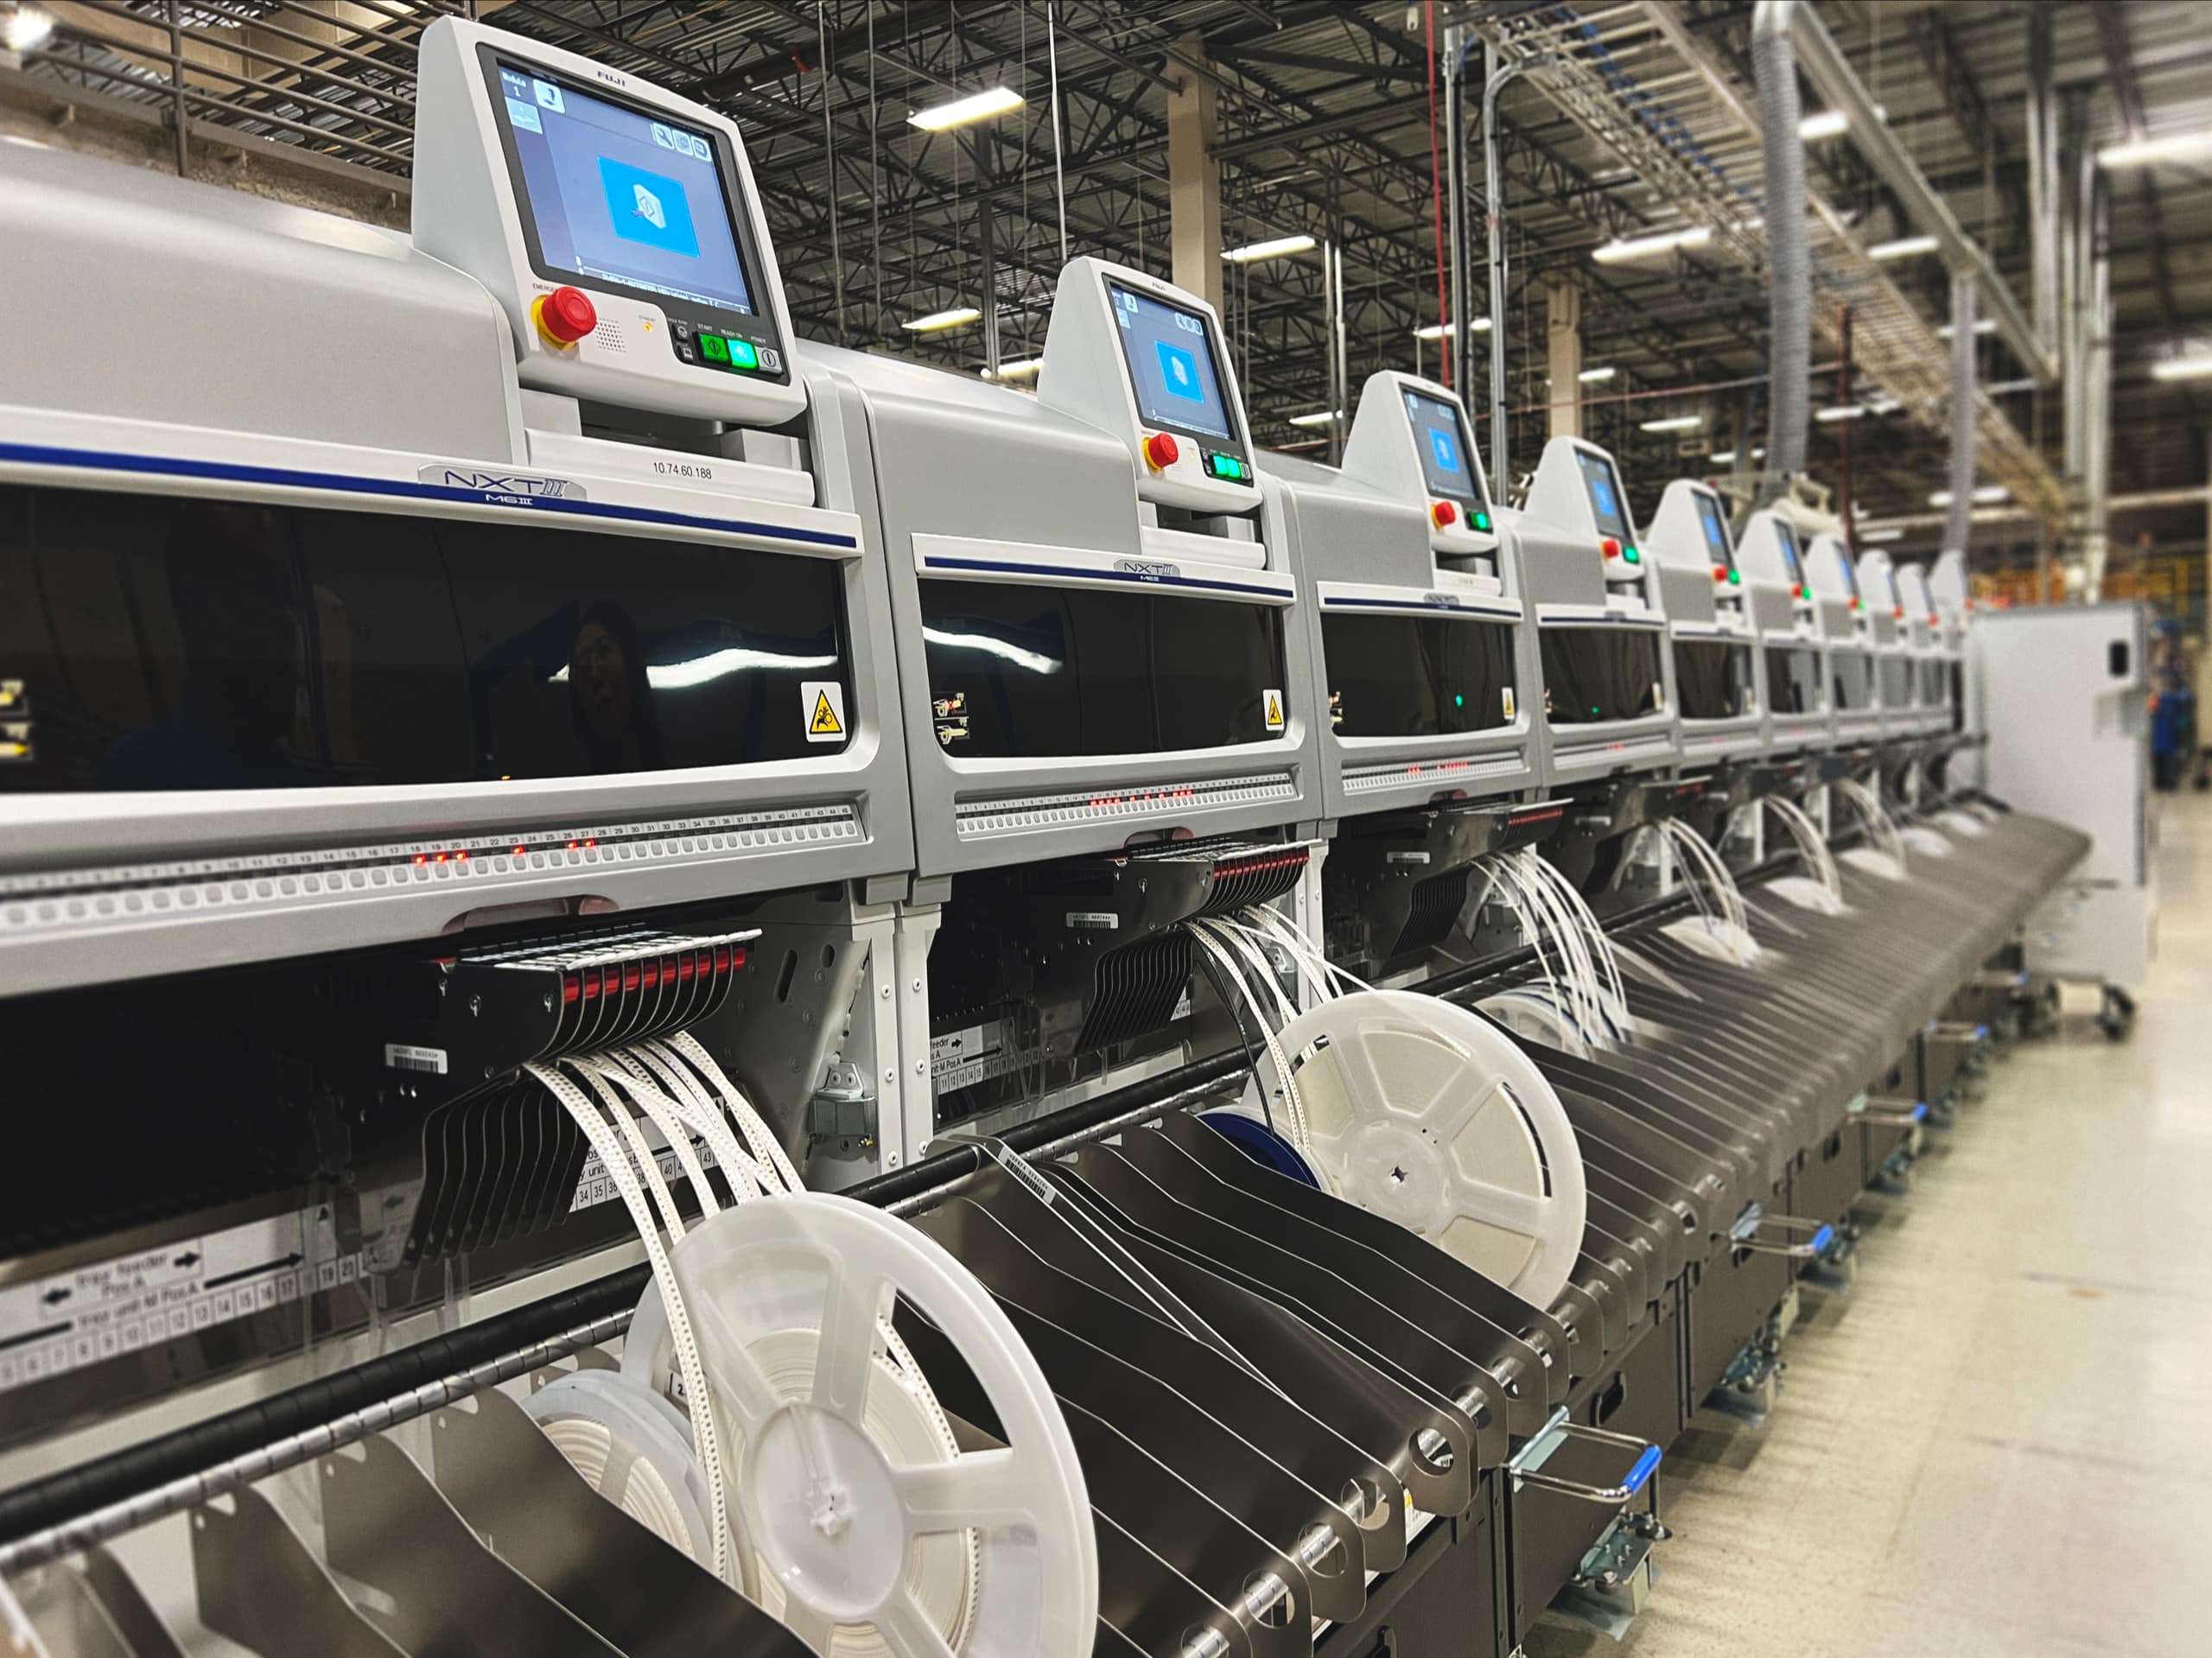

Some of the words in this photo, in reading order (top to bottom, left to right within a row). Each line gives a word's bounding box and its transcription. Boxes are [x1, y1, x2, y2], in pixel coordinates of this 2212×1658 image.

[942, 1078, 948, 1089] 11
[950, 1075, 957, 1086] 12
[959, 1072, 966, 1083] 13
[968, 1070, 975, 1080] 14
[976, 1067, 982, 1077] 15
[579, 1188, 588, 1203] 34
[594, 1184, 604, 1198] 35
[664, 1163, 673, 1176] 40
[702, 1151, 712, 1163] 43
